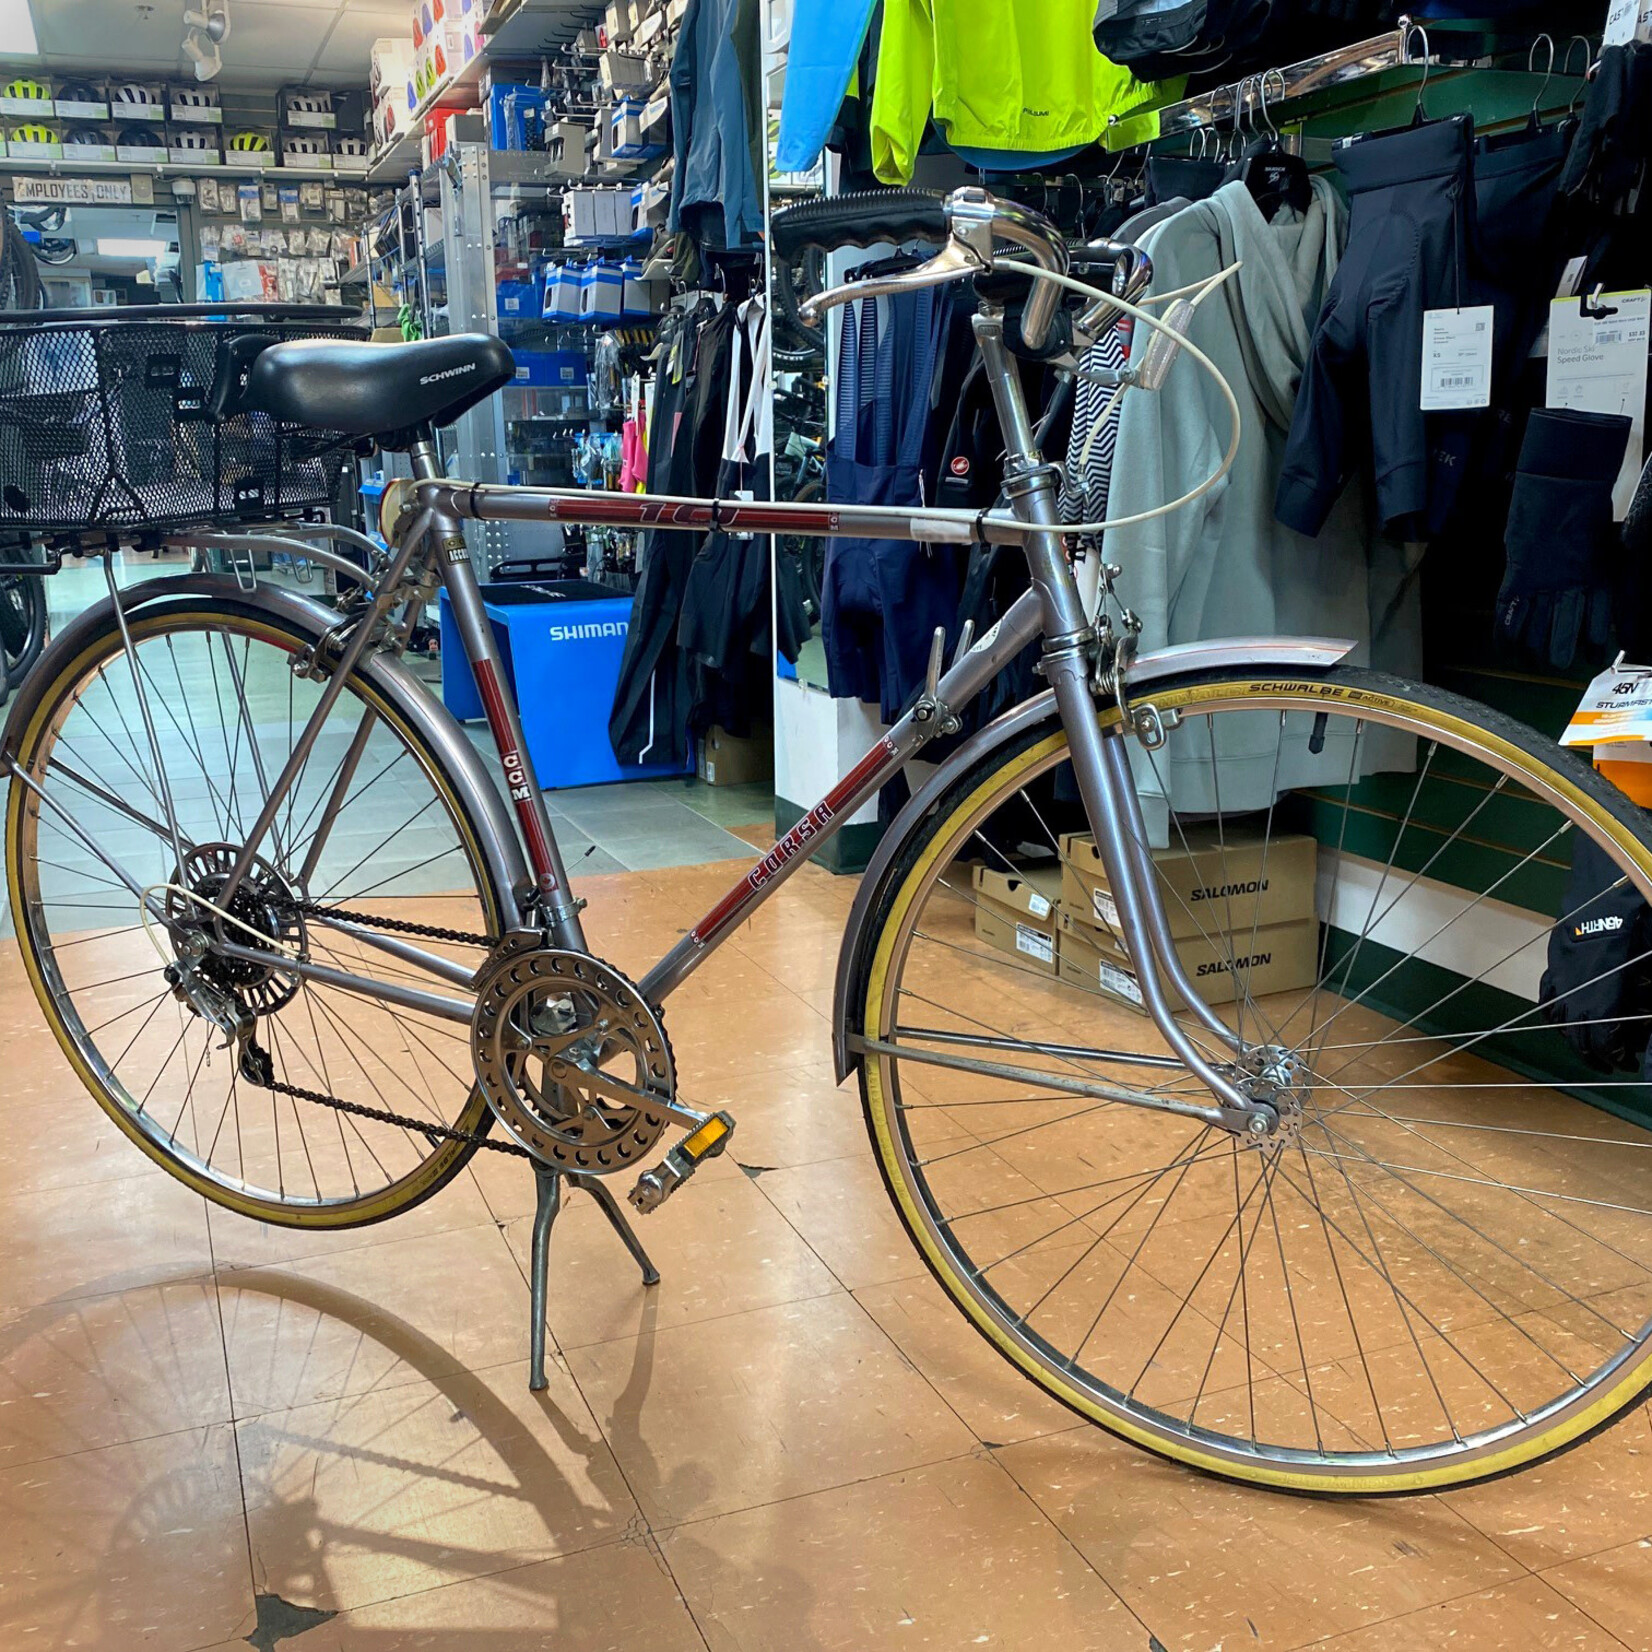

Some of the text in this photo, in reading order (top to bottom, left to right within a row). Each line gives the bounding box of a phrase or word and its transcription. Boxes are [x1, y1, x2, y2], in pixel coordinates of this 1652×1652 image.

[96, 184, 127, 200] ONLY
[1557, 347, 1582, 355] Nordic
[1557, 355, 1581, 364] Speed
[420, 363, 476, 385] SCHWINN
[550, 621, 629, 641] SHIMAN
[1249, 683, 1345, 697] SCHWALBE
[503, 753, 532, 801] CCM
[748, 801, 834, 891] CORSA
[1191, 879, 1270, 902] SALOMON
[1581, 916, 1623, 935] 45NRTH
[1196, 953, 1272, 977] SALOMON
